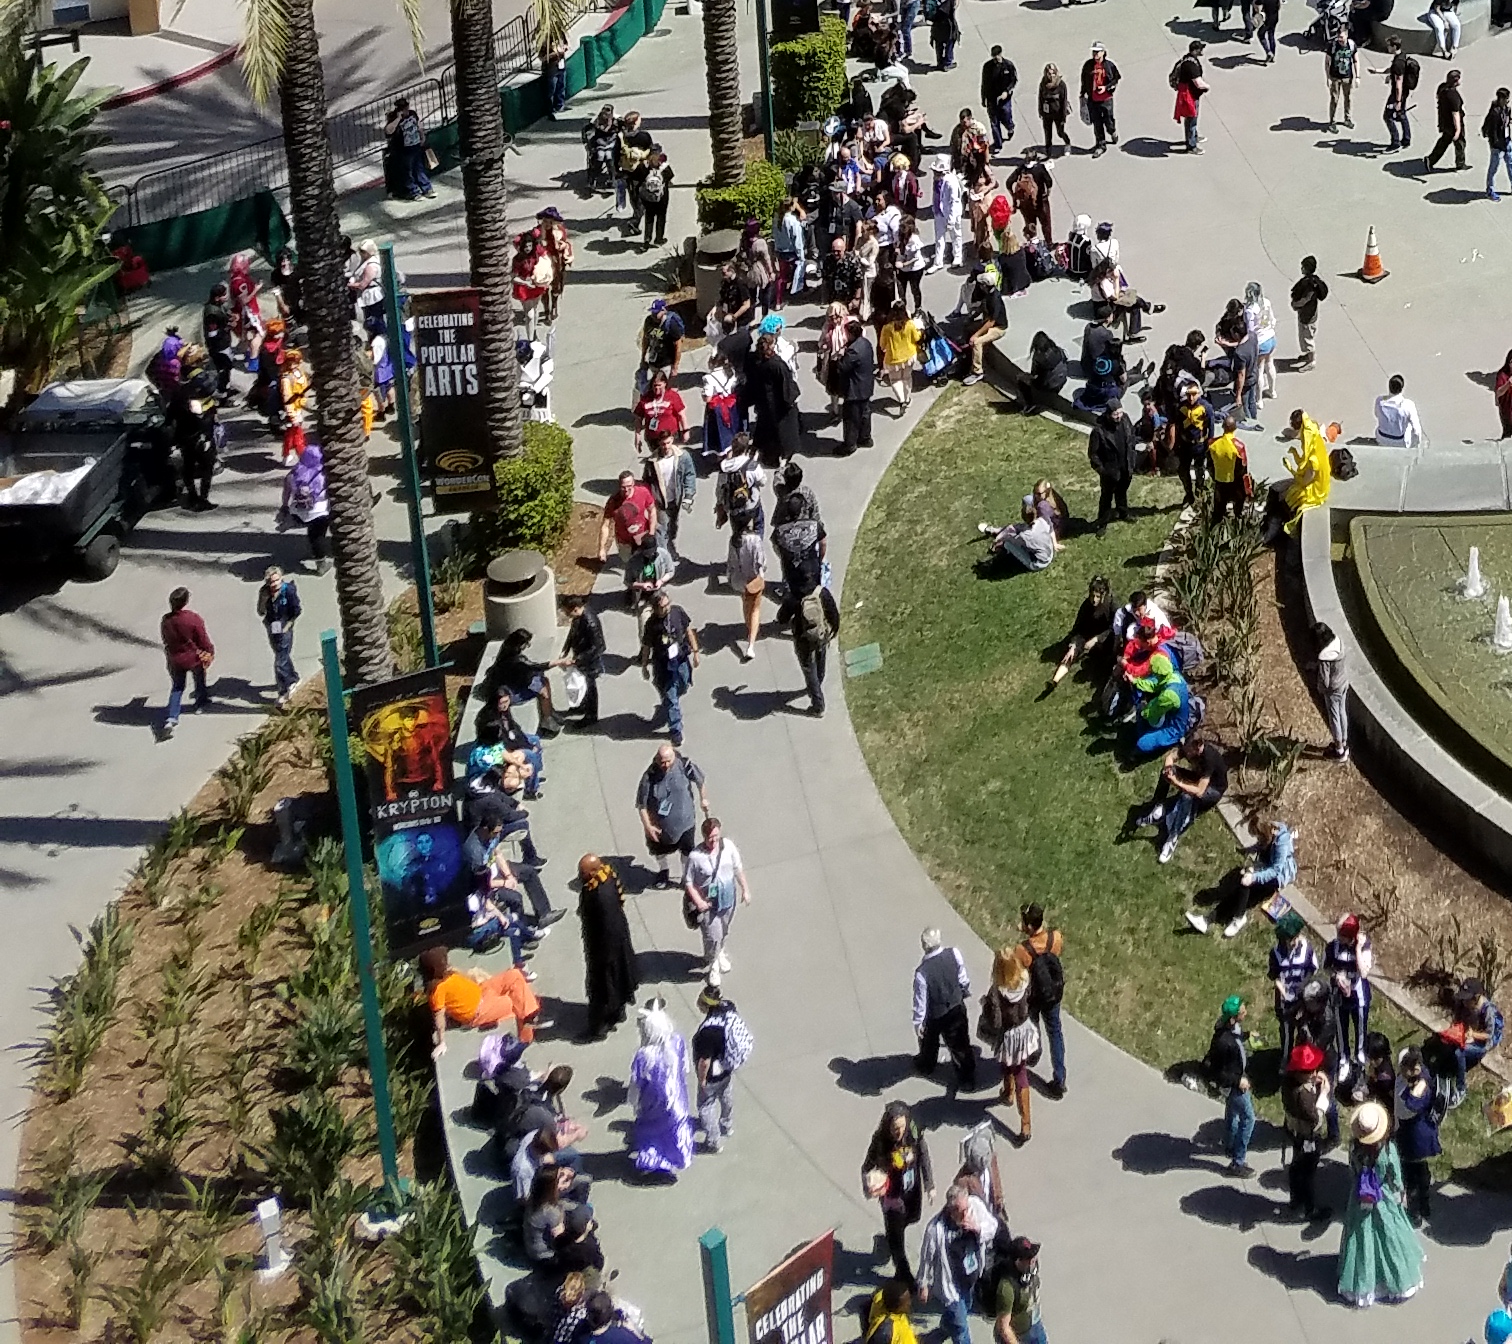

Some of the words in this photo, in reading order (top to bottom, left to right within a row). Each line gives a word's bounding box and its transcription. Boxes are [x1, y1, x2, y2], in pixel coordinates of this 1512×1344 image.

[419, 312, 474, 328] CELEBRATING
[438, 329, 456, 343] THE
[421, 344, 476, 364] POPULAR
[425, 364, 479, 396] ARTS
[376, 792, 453, 819] KRYPTON
[755, 1267, 824, 1341] CELEBRATING
[782, 1307, 805, 1344] THE
